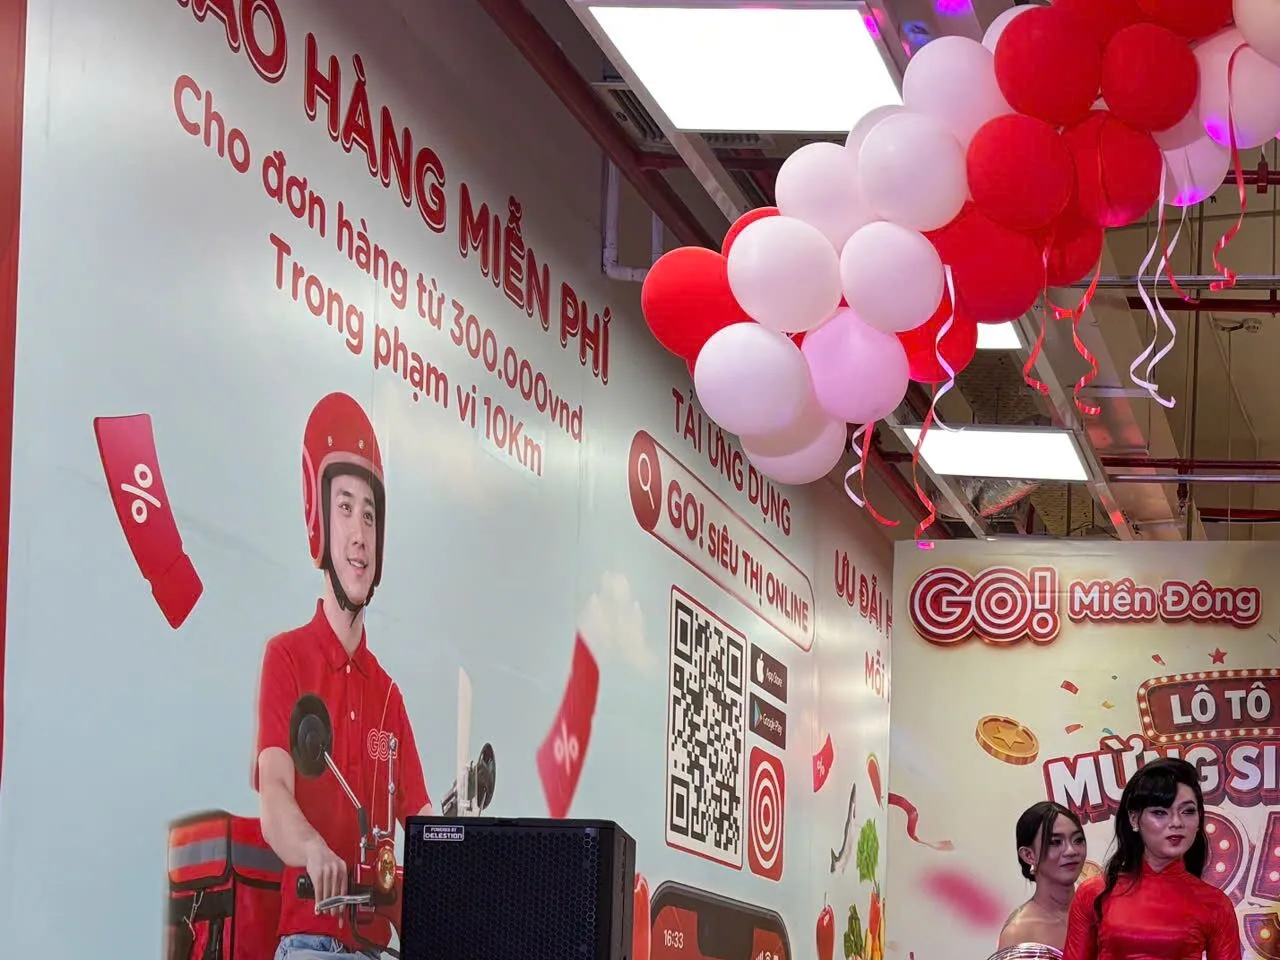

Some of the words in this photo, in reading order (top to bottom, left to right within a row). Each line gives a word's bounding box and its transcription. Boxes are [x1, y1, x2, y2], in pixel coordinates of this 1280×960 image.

[173, 74, 250, 174] Cho
[262, 150, 326, 238] đơn
[336, 201, 408, 310] hàng
[416, 272, 445, 330] từ
[450, 299, 583, 443] 300.000vnd
[304, 31, 447, 234] HÀNG
[459, 182, 551, 332] MIỄN
[560, 281, 612, 386] PHÍ
[269, 232, 364, 356] Trong
[374, 323, 449, 409] phạm
[456, 384, 477, 428] vi
[483, 396, 542, 476] 10Km
[671, 387, 702, 453] TẢI
[748, 462, 791, 537] DỤNG
[667, 479, 705, 549] GO!
[708, 522, 739, 577] SIÊU
[742, 549, 763, 606] THỊ
[765, 572, 809, 632] ONLINE
[834, 549, 856, 607] ƯU
[908, 565, 1060, 646] GO!
[1070, 577, 1156, 619] Miền
[1161, 578, 1260, 623] Đông
[1170, 684, 1221, 725] LÔ
[1224, 681, 1271, 722] TÔ
[663, 928, 684, 949] 16:33
